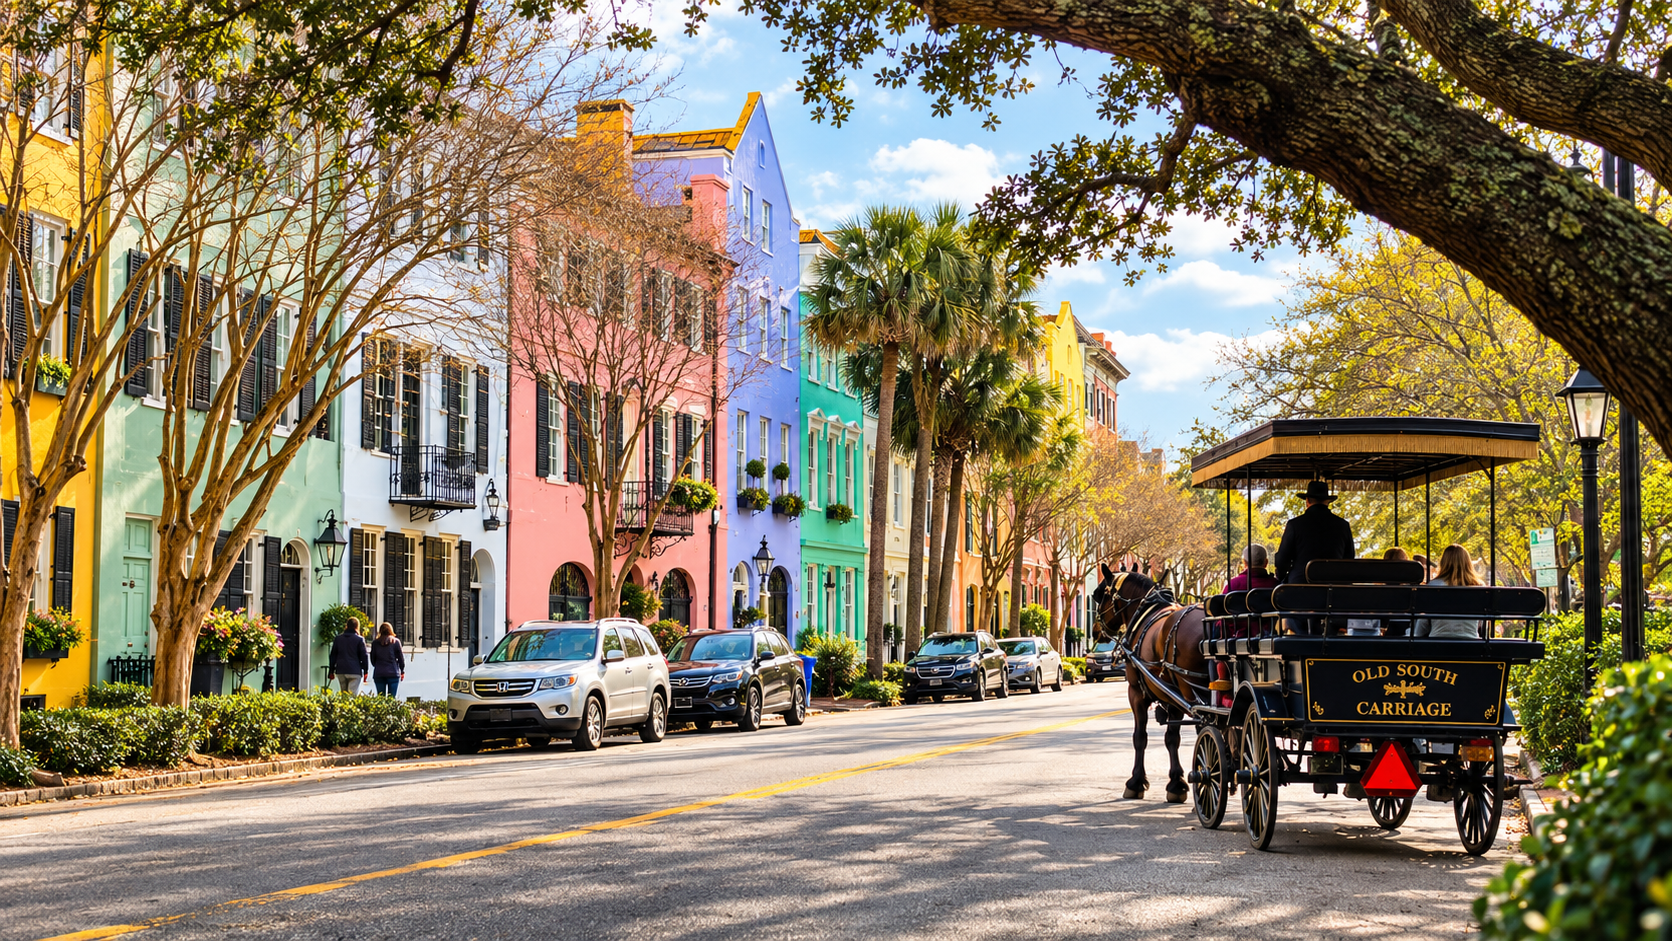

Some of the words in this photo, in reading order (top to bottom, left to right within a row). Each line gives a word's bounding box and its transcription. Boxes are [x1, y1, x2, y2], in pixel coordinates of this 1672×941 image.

[1352, 665, 1390, 683] OLD
[1397, 664, 1458, 686] SOUTH
[1356, 701, 1452, 717] CARRIAGE
